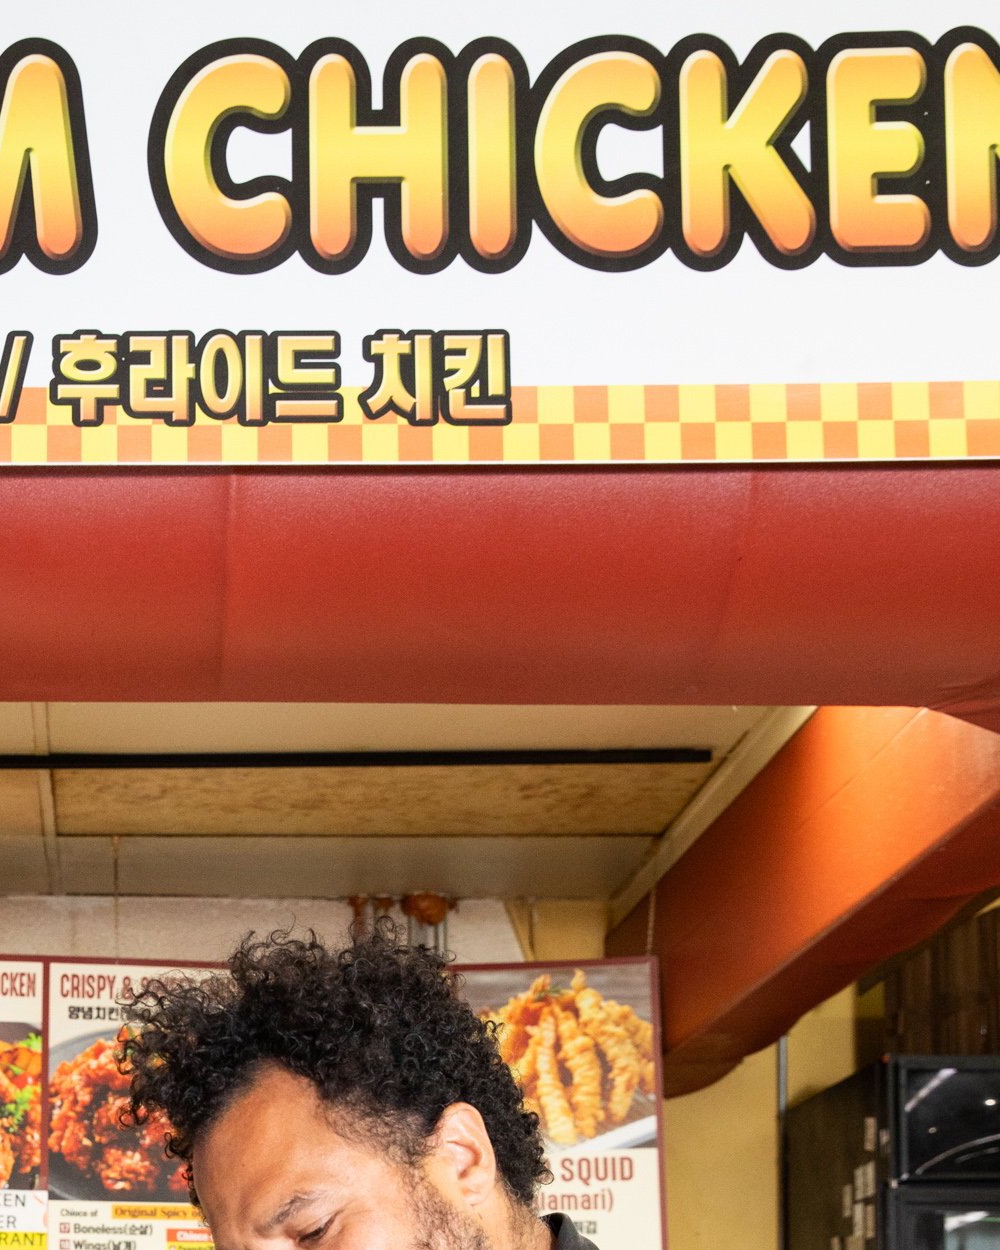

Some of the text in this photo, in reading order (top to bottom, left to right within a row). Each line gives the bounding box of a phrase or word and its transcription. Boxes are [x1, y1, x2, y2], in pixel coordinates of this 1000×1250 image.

[51, 329, 342, 426] 후라이드
[363, 328, 512, 426] 치킨
[60, 974, 116, 999] CRISPY
[561, 1156, 634, 1185] SQUID
[115, 1207, 157, 1218] Original
[161, 1208, 188, 1219] Spicy
